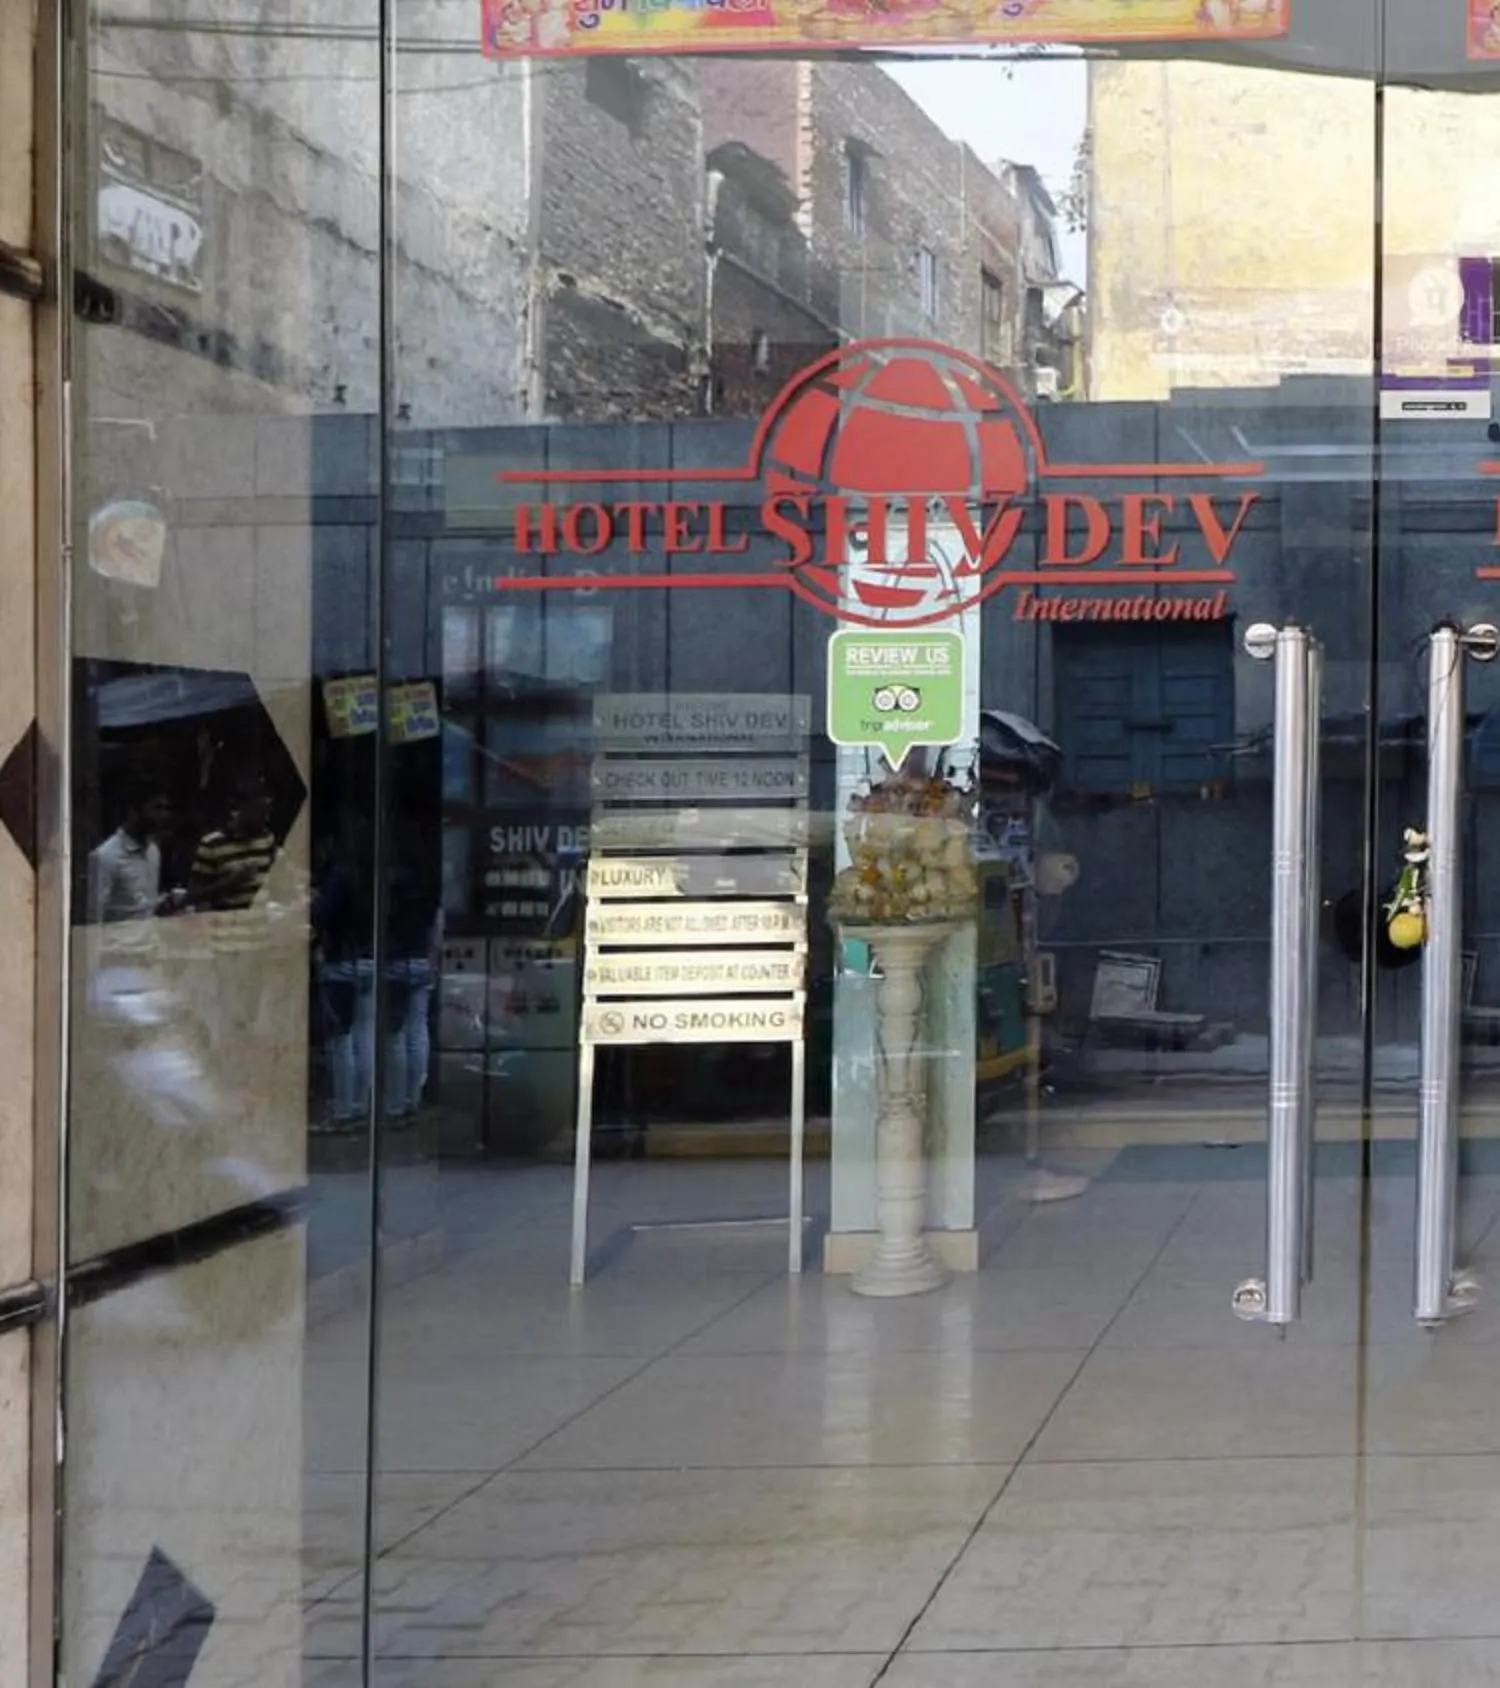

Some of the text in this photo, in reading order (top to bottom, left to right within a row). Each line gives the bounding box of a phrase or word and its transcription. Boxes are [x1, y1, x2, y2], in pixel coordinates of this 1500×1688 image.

[513, 491, 1259, 570] HOTEL SHIV DEV
[1011, 590, 1229, 624] International
[846, 647, 949, 665] REVIEW US
[612, 710, 788, 730] HOTEL SHIV DEV
[605, 769, 795, 788] CHECK OUT TIME 12 NOON
[489, 826, 550, 853] SHIV
[556, 826, 590, 853] DE
[601, 866, 667, 887] LUXURY
[632, 1011, 786, 1030] NO SMOKING
